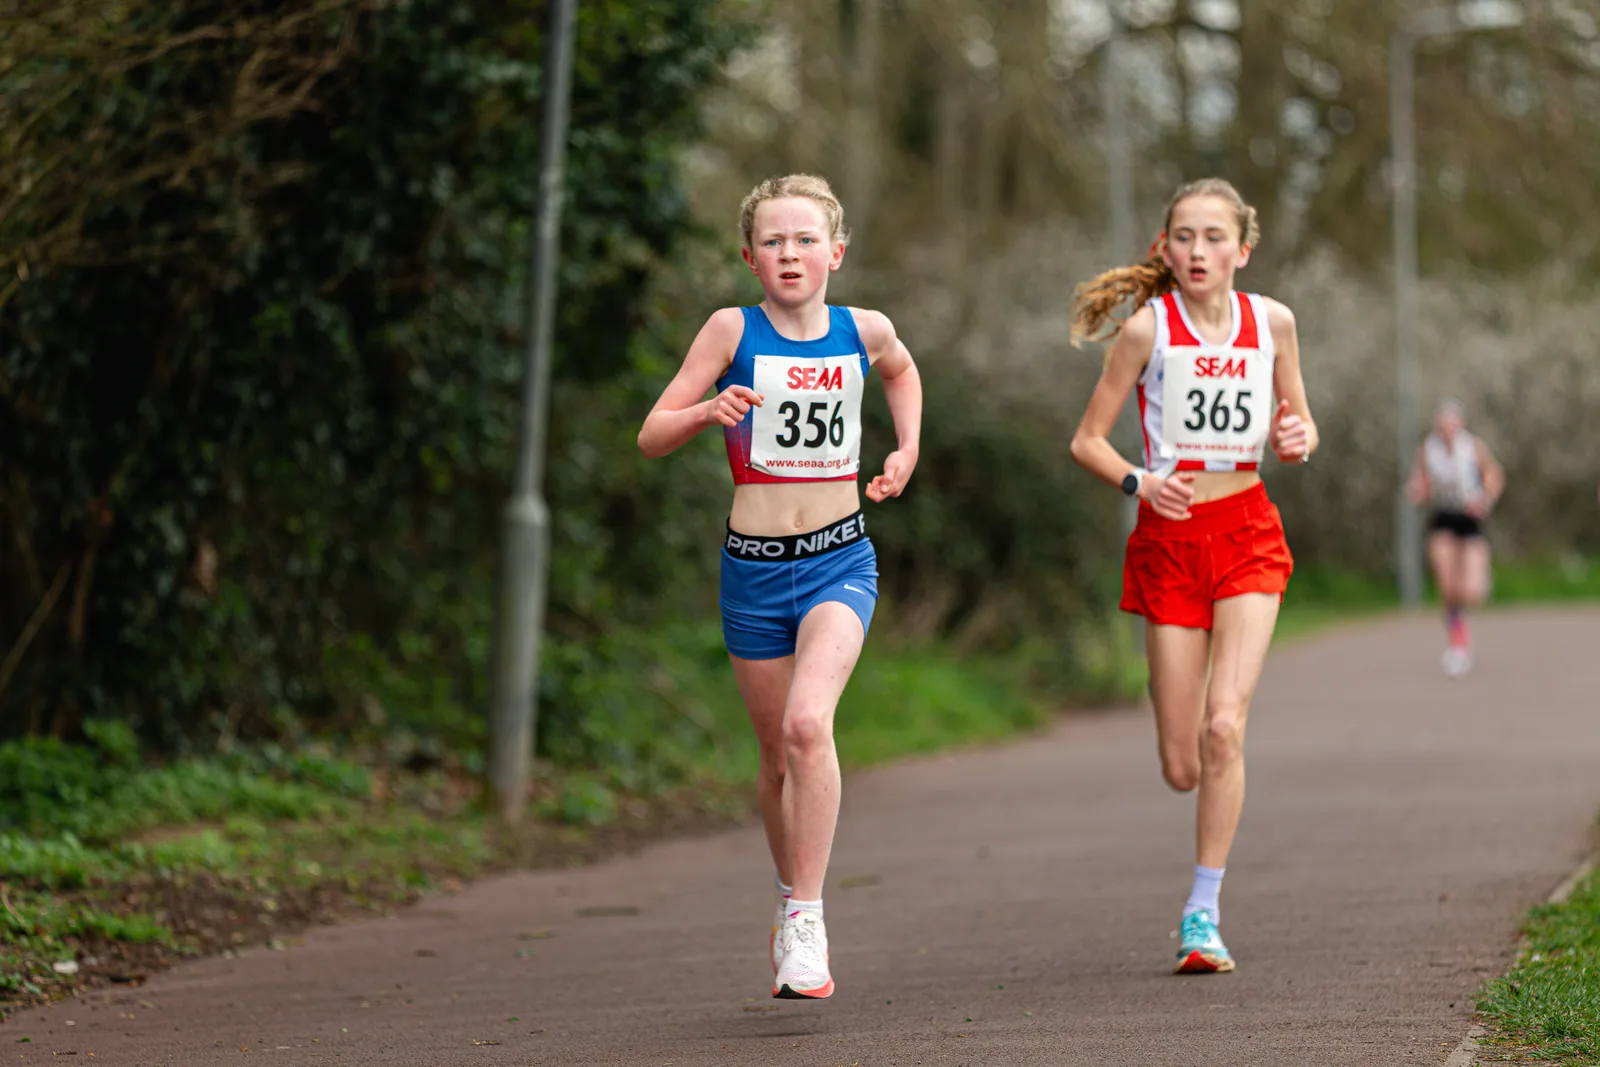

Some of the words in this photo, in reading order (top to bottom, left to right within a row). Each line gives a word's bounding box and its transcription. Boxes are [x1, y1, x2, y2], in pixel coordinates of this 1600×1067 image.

[787, 366, 842, 390] SEAA
[1195, 356, 1246, 379] SEAA
[776, 401, 844, 448] 356
[1185, 390, 1252, 432] 365
[766, 456, 851, 469] www.seaa.org.uk
[727, 534, 785, 557] PRO
[794, 518, 859, 556] NIKE
